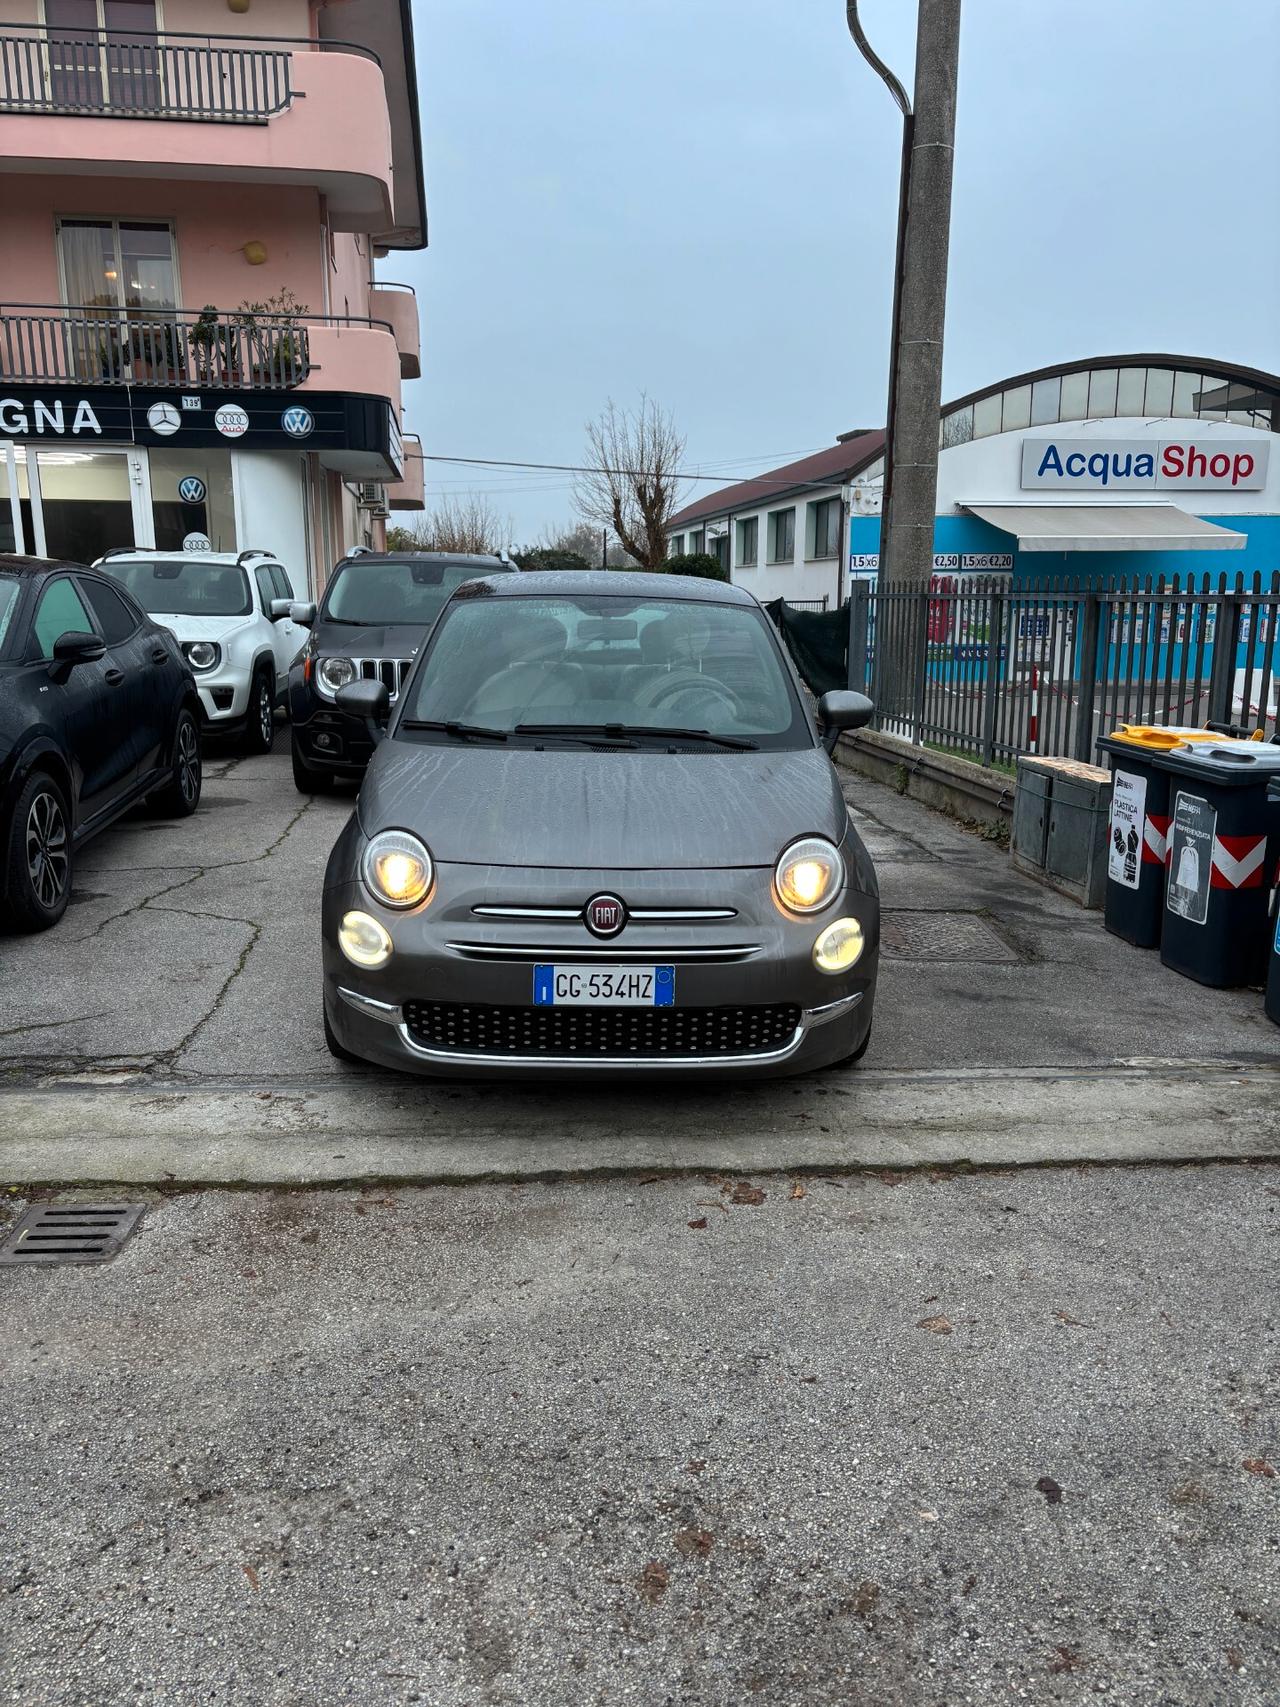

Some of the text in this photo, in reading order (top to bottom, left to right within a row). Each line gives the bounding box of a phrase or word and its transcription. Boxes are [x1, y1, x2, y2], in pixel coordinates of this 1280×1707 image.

[220, 425, 246, 433] Audi
[1037, 444, 1255, 486] Acqua Shop
[934, 555, 957, 568] €2,50
[989, 555, 1011, 568] €2,20
[595, 907, 616, 924] FIAT
